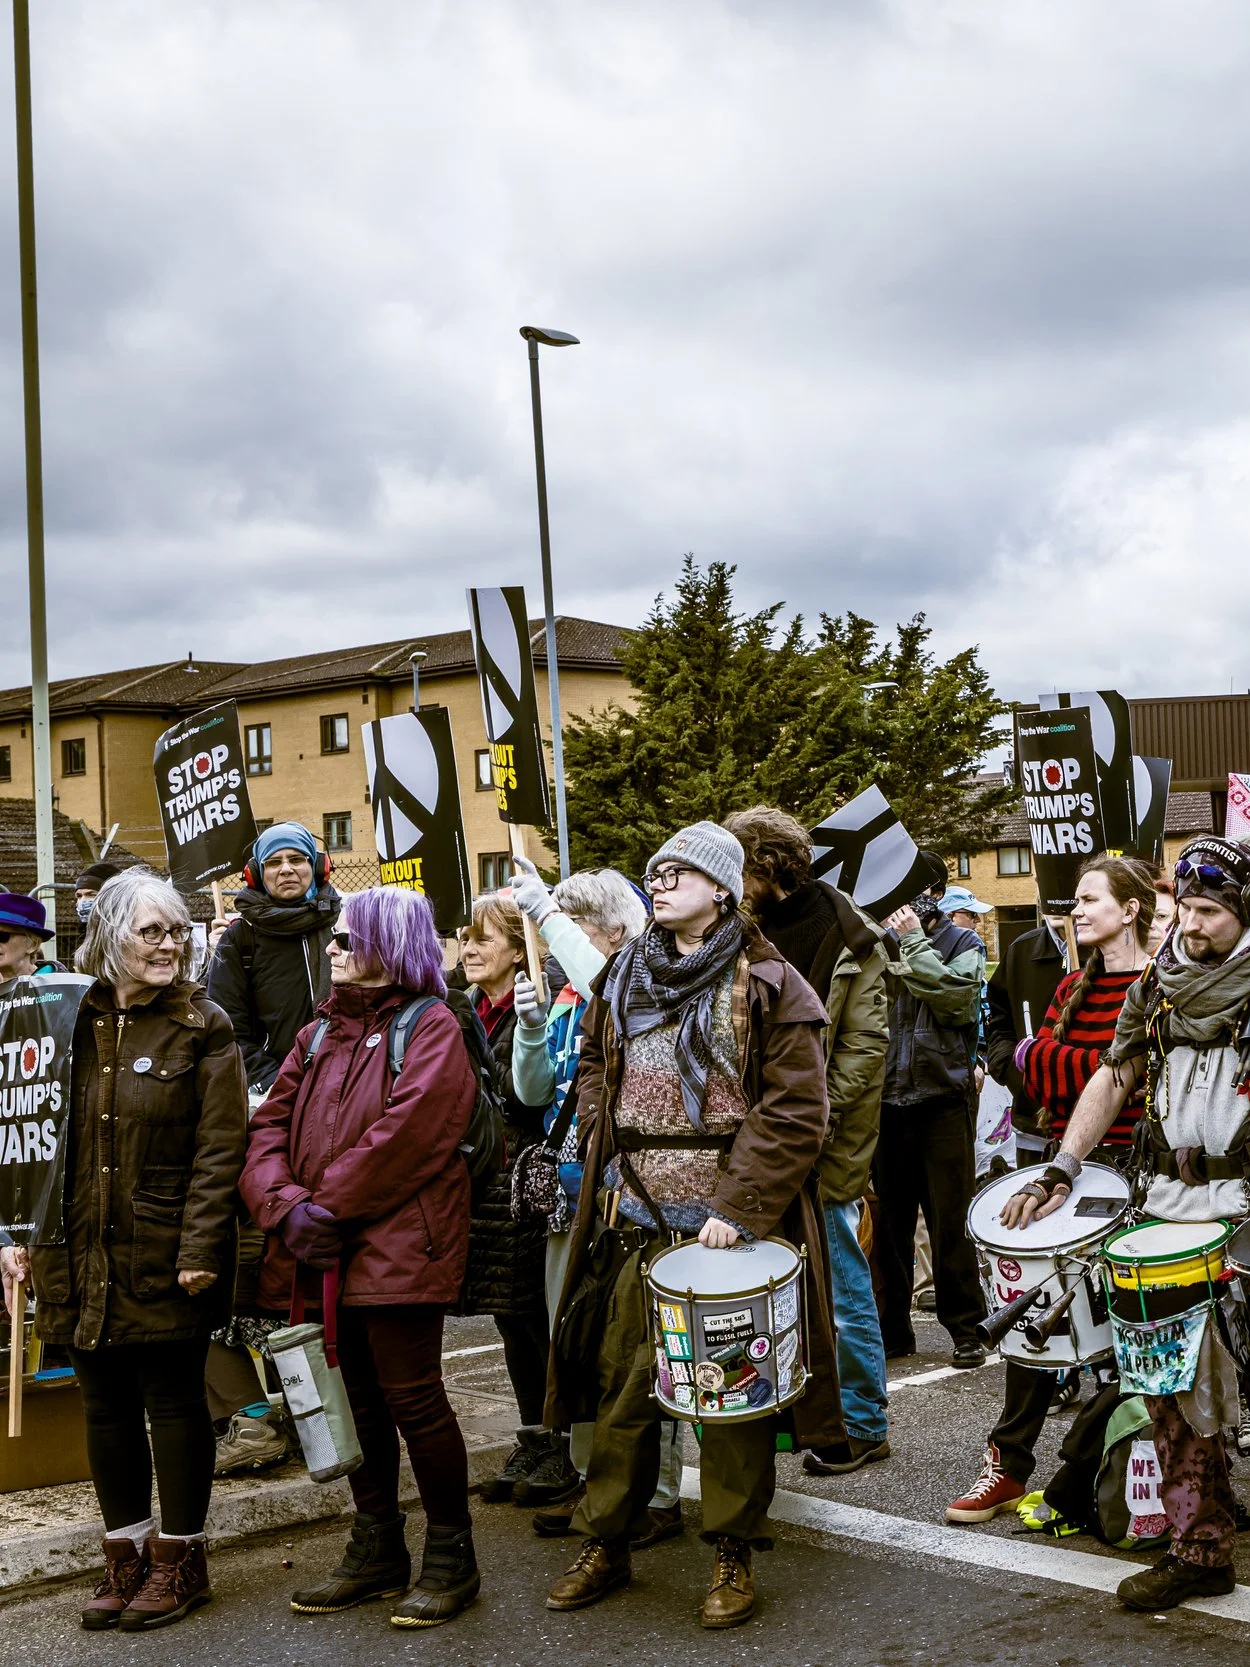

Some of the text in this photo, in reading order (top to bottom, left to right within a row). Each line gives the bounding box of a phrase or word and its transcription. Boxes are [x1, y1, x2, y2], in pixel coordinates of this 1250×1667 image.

[170, 717, 224, 746] Stop the War coalition
[1036, 726, 1049, 734] War
[1050, 724, 1076, 732] coalition
[168, 744, 229, 794] STOP
[1023, 758, 1080, 792] STOP
[165, 768, 240, 819] TRUMP'S
[1025, 793, 1095, 819] TRUMP'S
[172, 794, 240, 846] WARS
[1029, 821, 1094, 855] WARS
[395, 858, 422, 881] OUT
[21, 996, 35, 1006] War
[36, 992, 62, 1003] coalition
[0, 1035, 55, 1082] TOP
[737, 1328, 753, 1338] FUELS
[1135, 1348, 1186, 1373] PEACE
[1132, 1458, 1155, 1477] WE
[1132, 1483, 1151, 1500] IN
